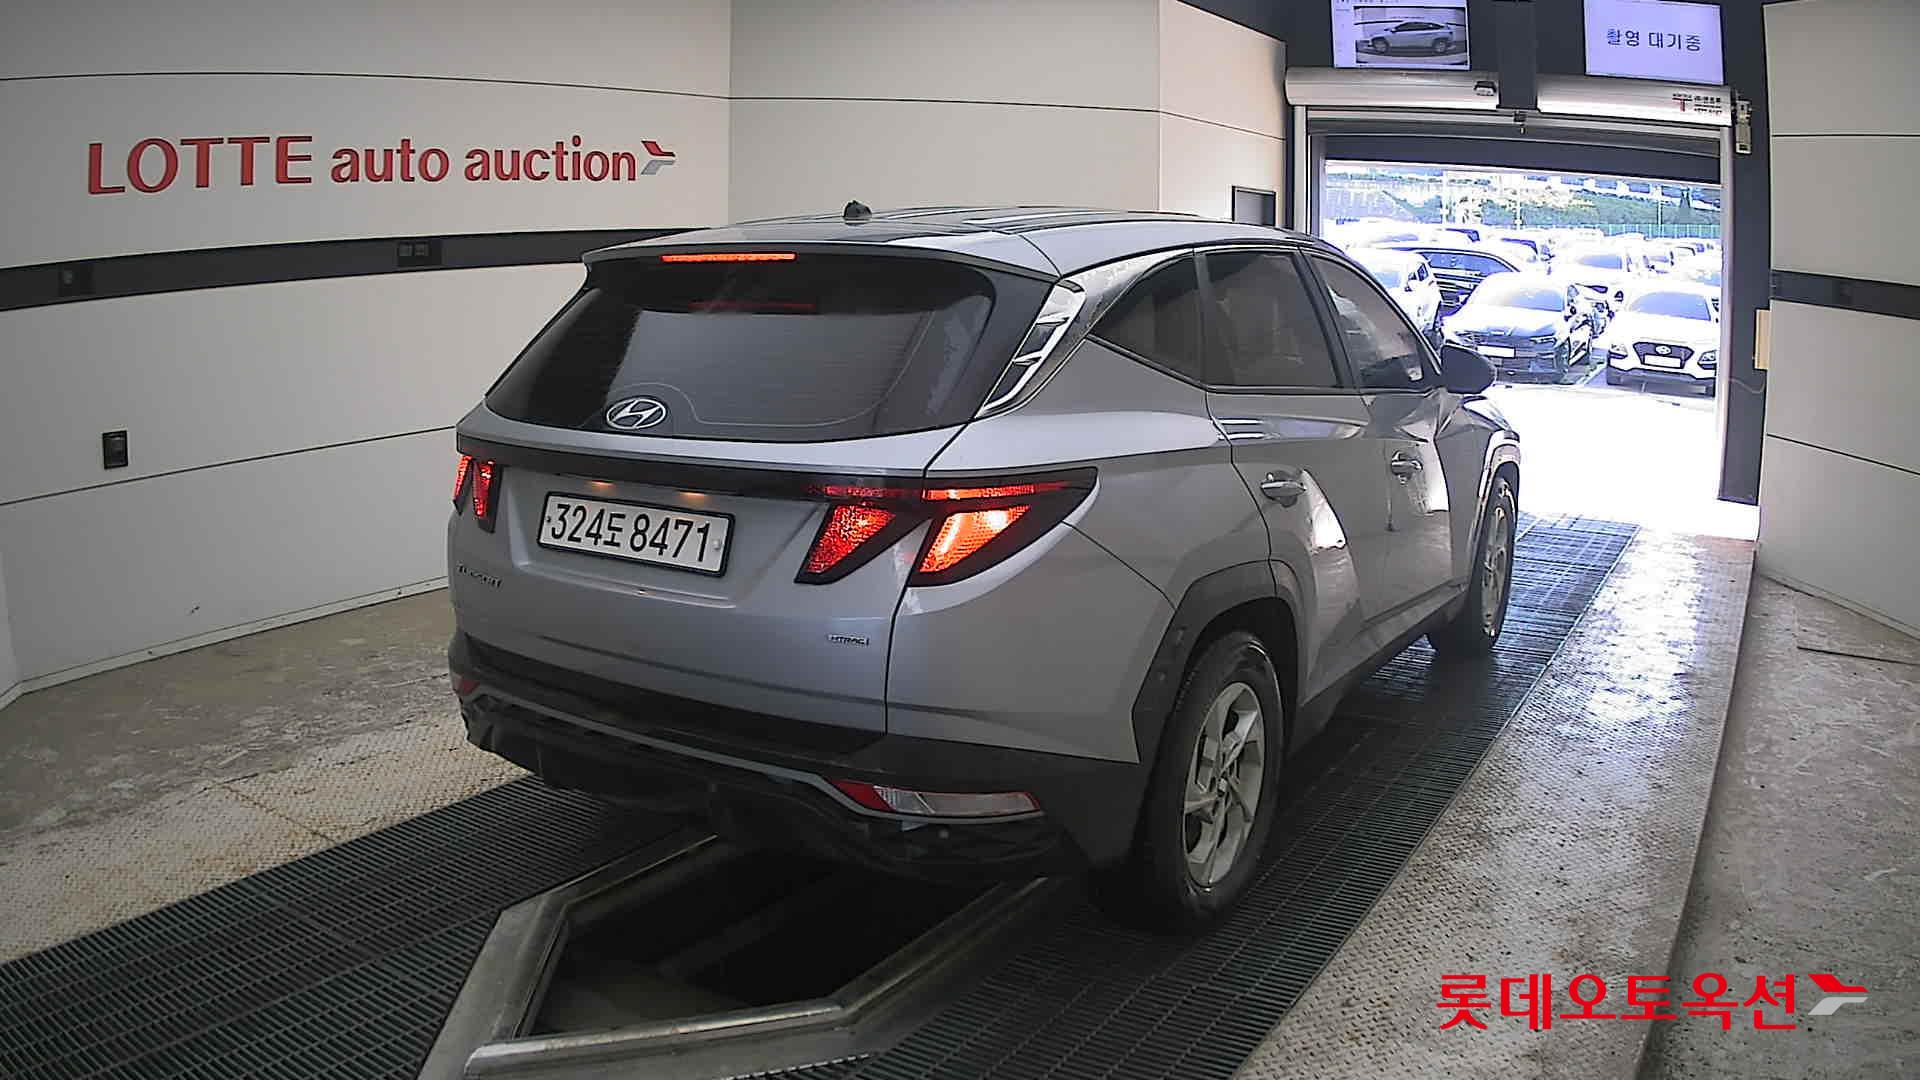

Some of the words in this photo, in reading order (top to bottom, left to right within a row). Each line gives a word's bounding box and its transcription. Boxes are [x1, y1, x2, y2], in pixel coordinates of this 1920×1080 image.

[1648, 32, 1701, 52] 대기중
[87, 135, 314, 194] LOTTE
[331, 138, 450, 183] auto
[464, 135, 638, 182] auction
